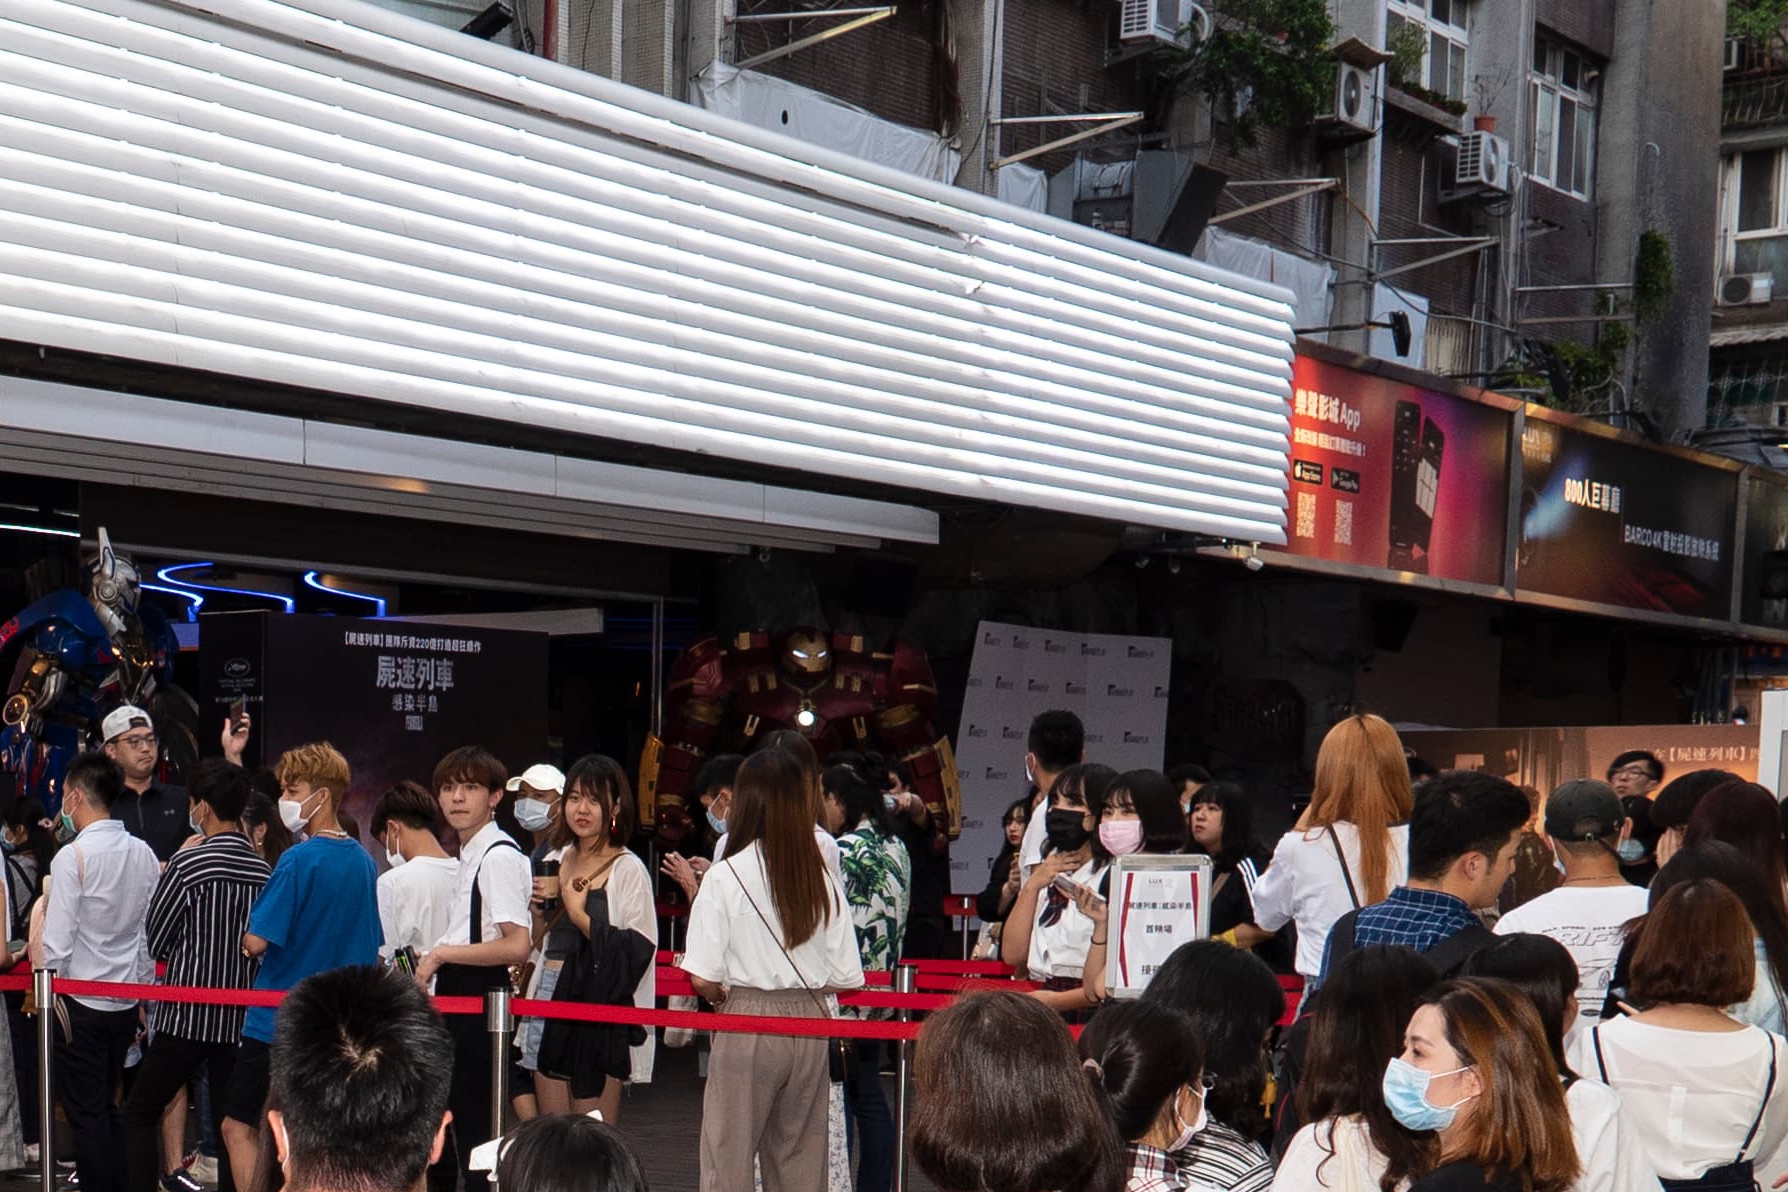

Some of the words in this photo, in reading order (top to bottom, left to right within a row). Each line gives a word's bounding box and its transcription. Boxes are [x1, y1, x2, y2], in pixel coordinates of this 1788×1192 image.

[1340, 402, 1361, 432] App
[1564, 477, 1621, 515] 800人巨幕廳
[1624, 524, 1652, 546] BARCO
[376, 655, 454, 691] 屍速列車
[392, 693, 438, 712] 感染半島
[1145, 924, 1173, 934] 首映場
[1559, 929, 1628, 947] RIFT
